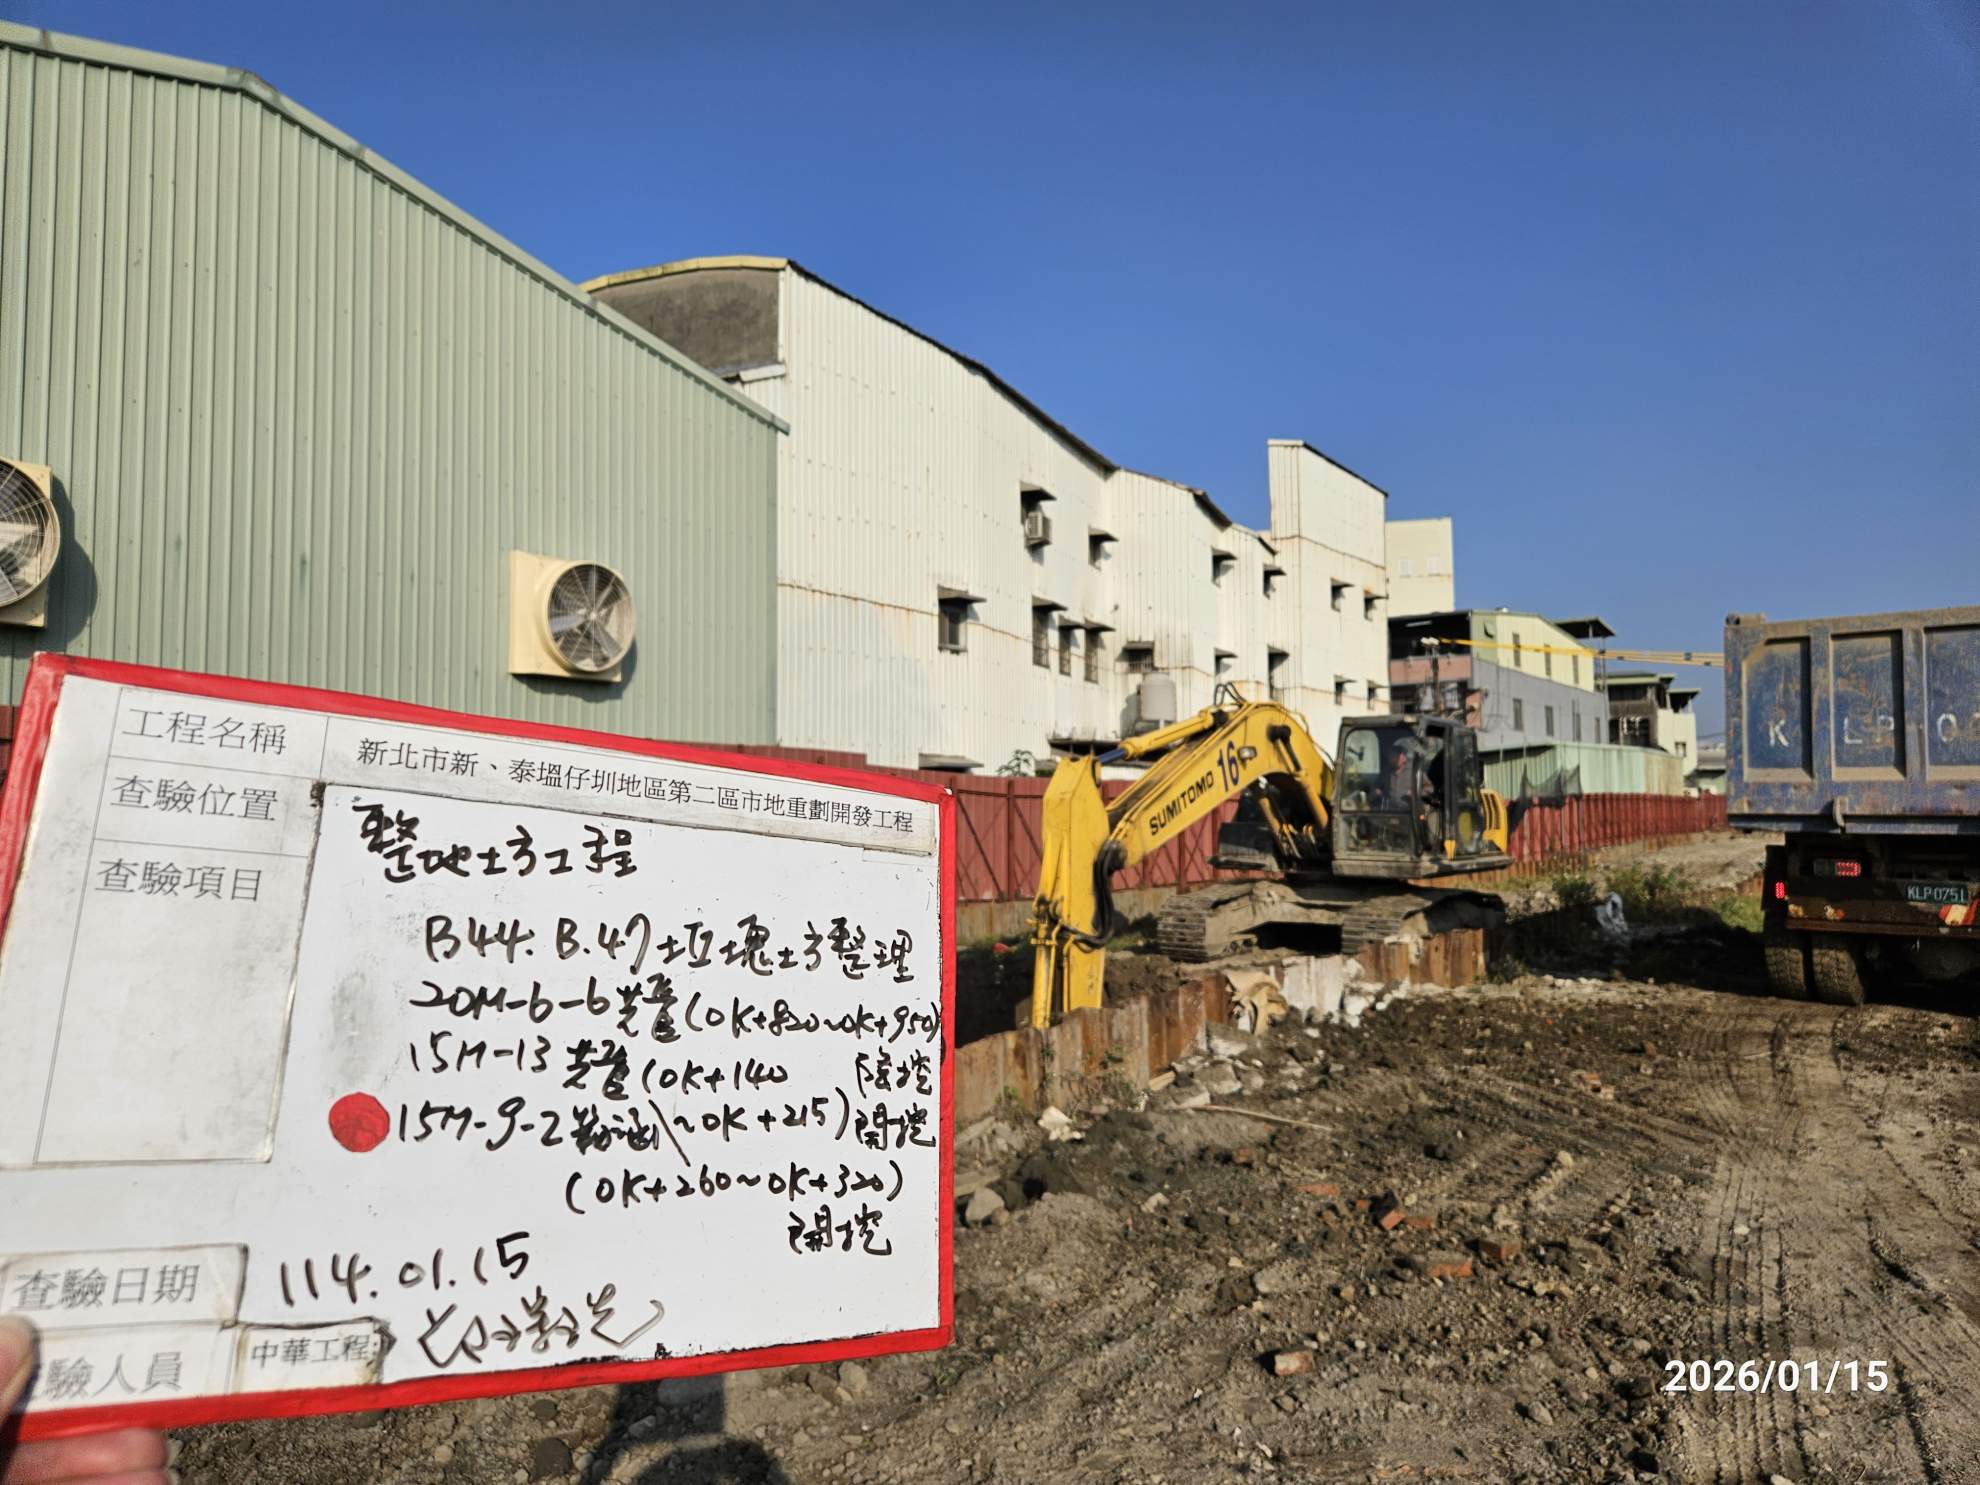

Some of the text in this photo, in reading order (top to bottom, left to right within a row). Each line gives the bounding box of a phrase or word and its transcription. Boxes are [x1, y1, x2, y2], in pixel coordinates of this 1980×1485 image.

[122, 708, 287, 756] 工程名稱
[357, 737, 913, 833] 新北市新、泰塭仔圳地區第二區市地重劃開發工程
[1217, 741, 1239, 792] 16
[110, 775, 278, 822] 查驗位置
[1149, 770, 1214, 836] SUMITOMO
[351, 803, 638, 883] 整地土方工程
[95, 858, 263, 902] 查驗項目
[14, 1264, 200, 1312] 查驗日期
[251, 1333, 372, 1369] 中華工程
[30, 1351, 184, 1401] 驗人員
